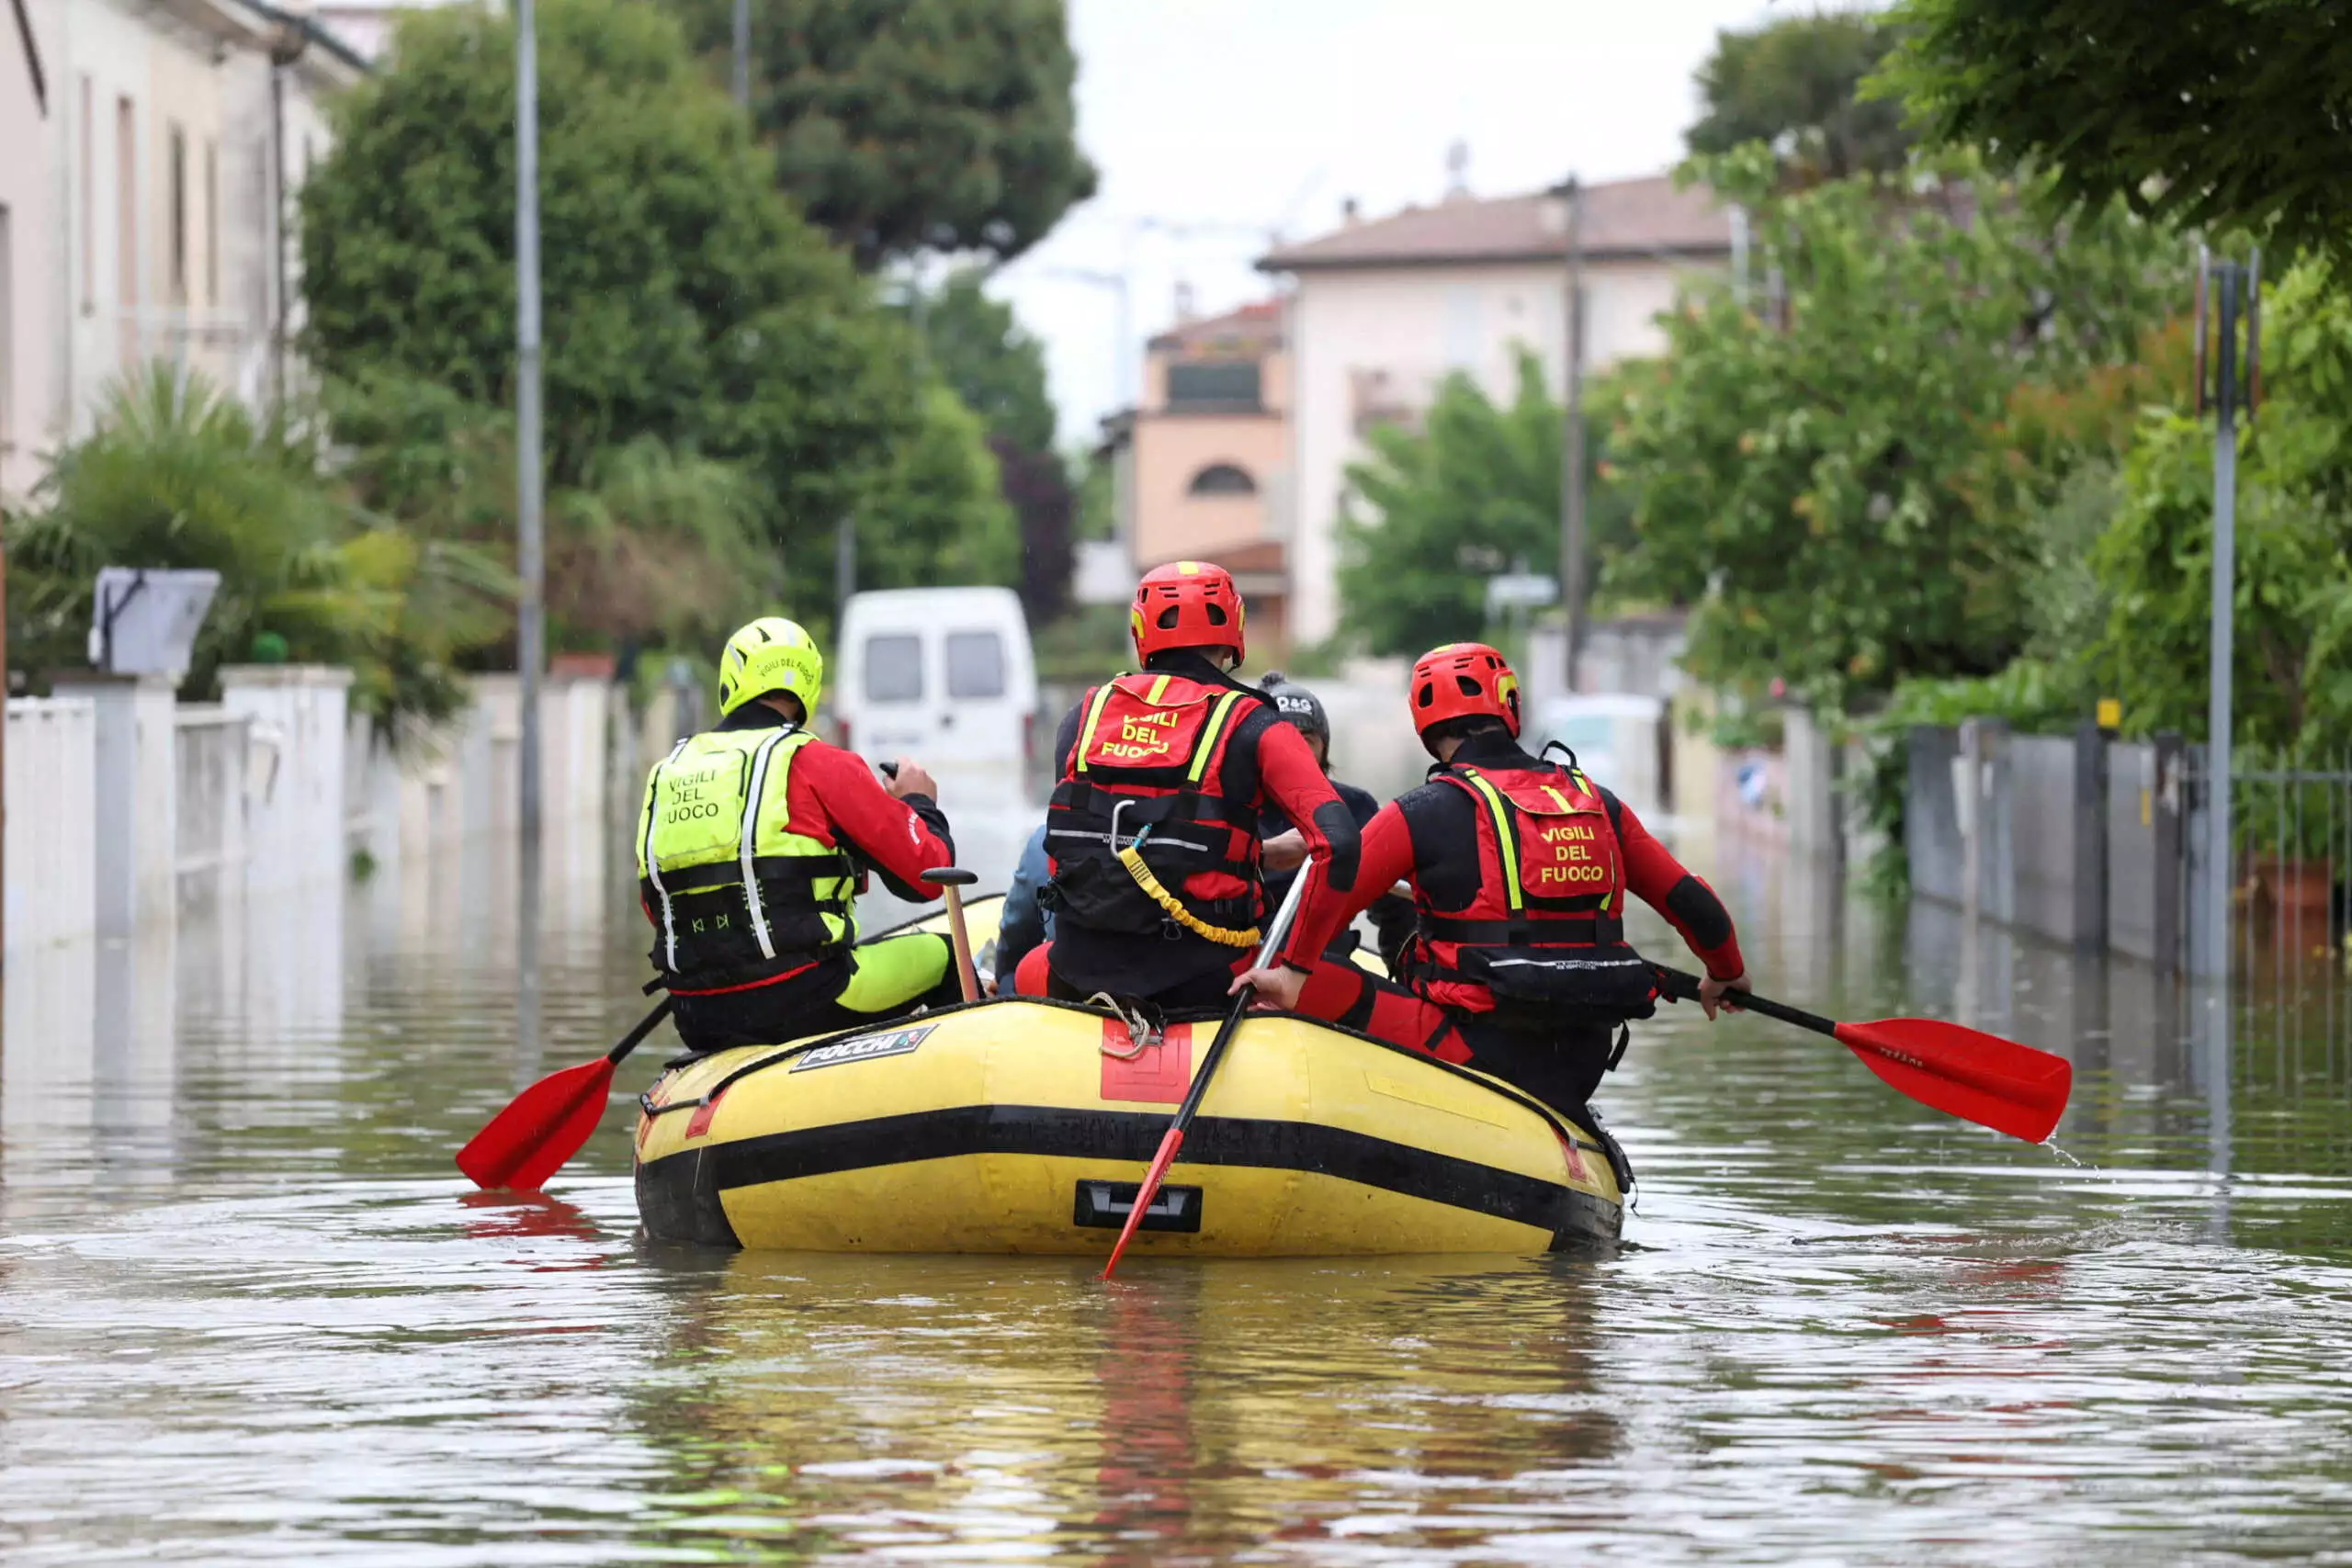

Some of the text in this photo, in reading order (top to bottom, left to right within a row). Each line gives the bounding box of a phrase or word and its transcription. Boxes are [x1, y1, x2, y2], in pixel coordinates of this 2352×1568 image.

[781, 658, 795, 668] DEL
[1276, 696, 1312, 711] D&G
[1123, 712, 1178, 728] VILI
[1122, 723, 1161, 745] DEL
[665, 803, 719, 824] UOCO
[1541, 826, 1595, 842] VIGILI
[1555, 845, 1592, 862] DEL
[1542, 866, 1604, 883] FUOCO
[801, 1034, 899, 1064] FOCCHI
